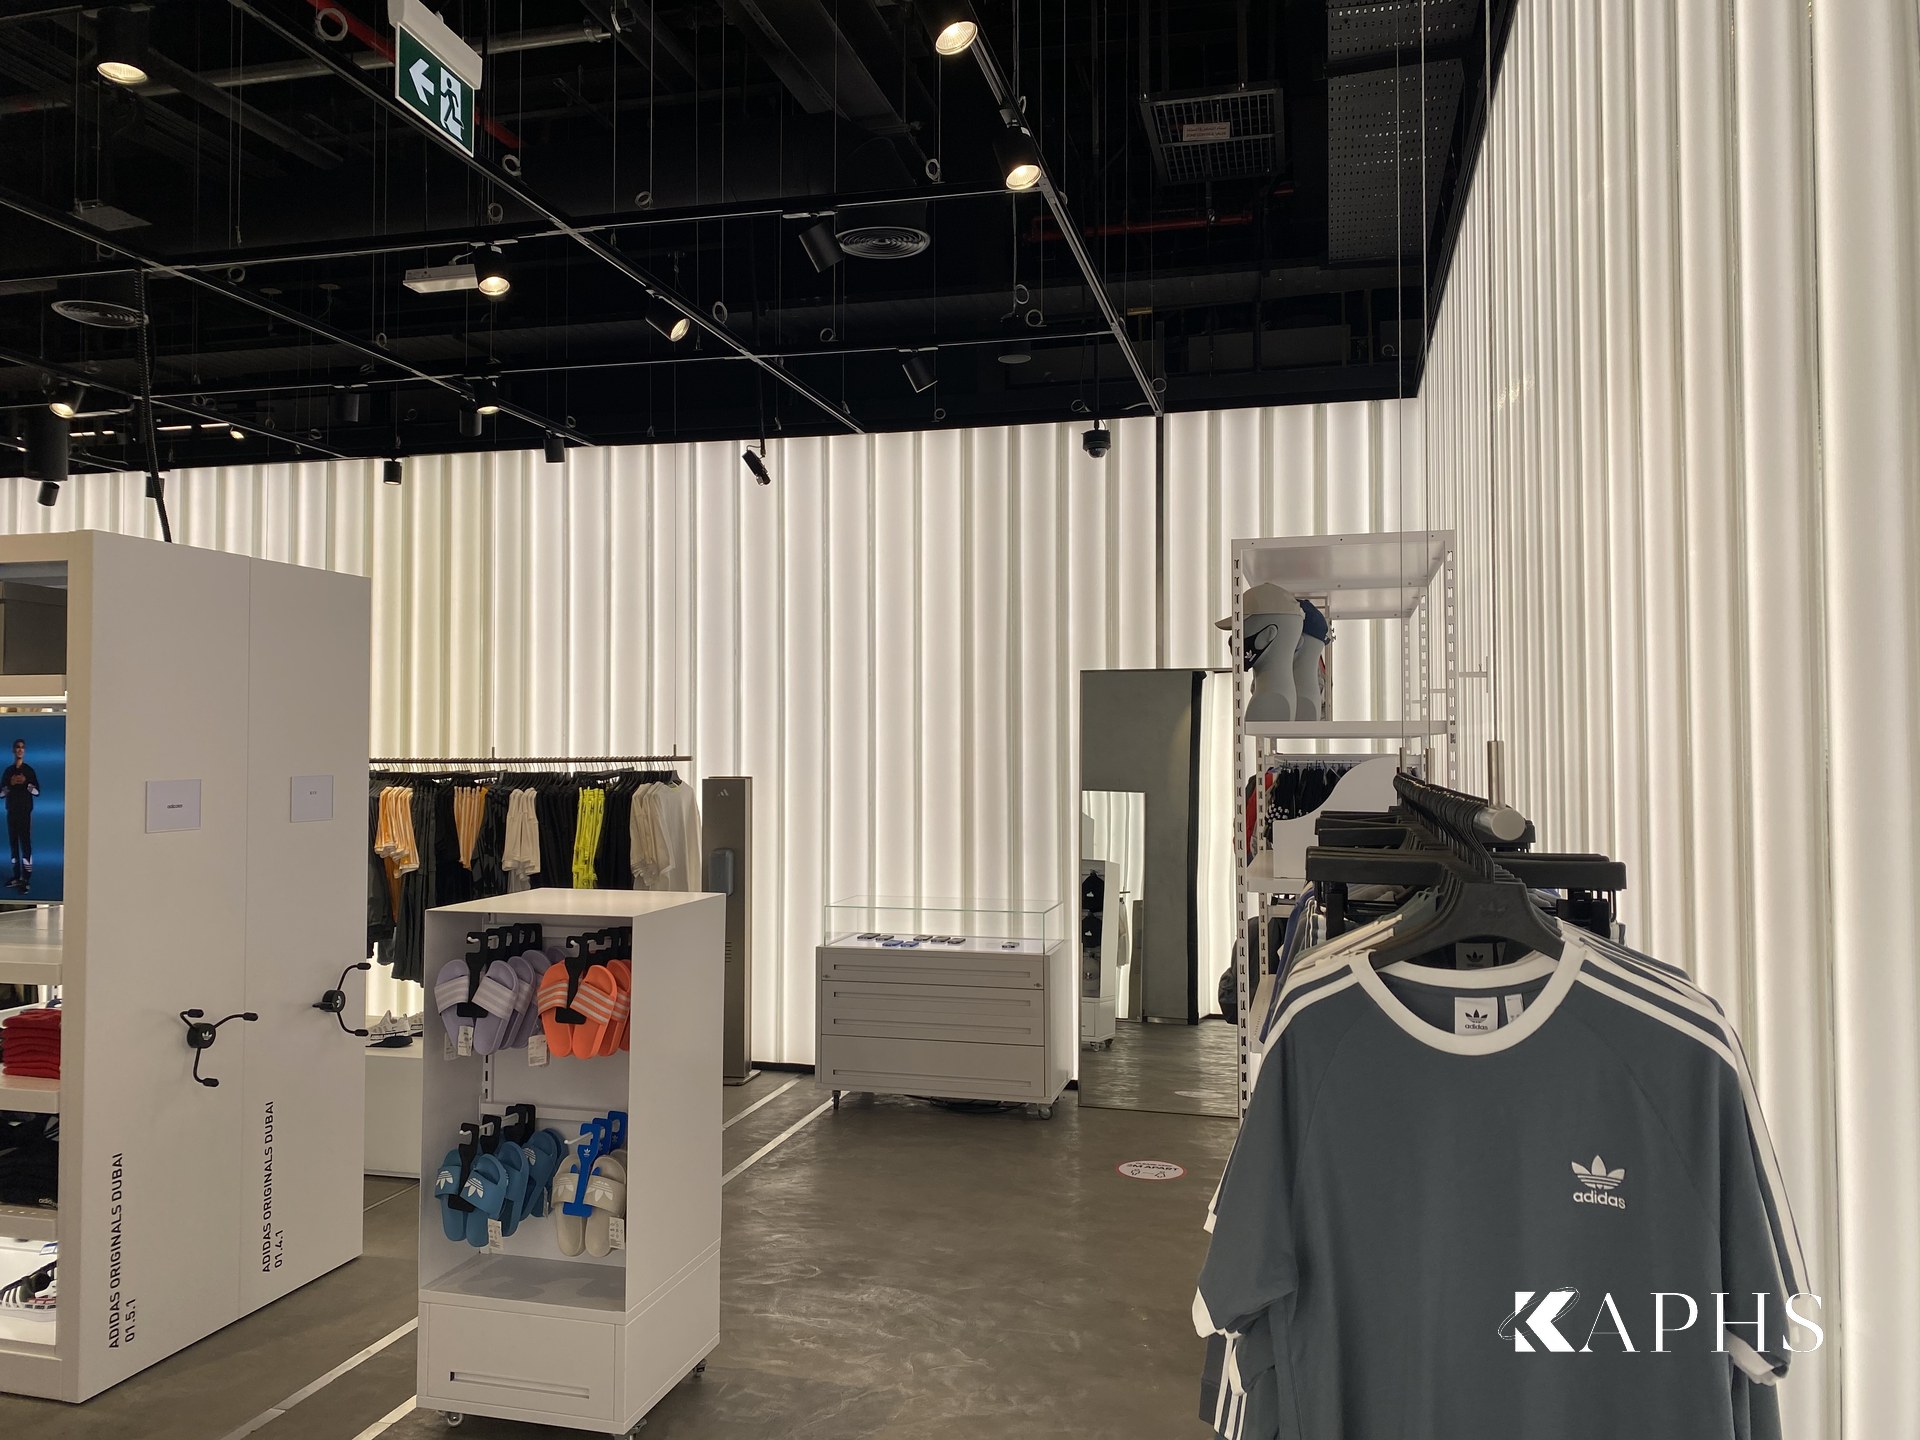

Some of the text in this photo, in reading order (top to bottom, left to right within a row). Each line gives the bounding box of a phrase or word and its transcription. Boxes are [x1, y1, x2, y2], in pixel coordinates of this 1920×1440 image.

[1464, 1023, 1489, 1031] adidas
[262, 1101, 274, 1272] ADIDAS ORIGINALS DUBAI
[1573, 1190, 1626, 1209] adidas
[108, 1152, 123, 1348] ADIDAS ORIGINALS DUBAI
[274, 1230, 284, 1268] 01.4.1
[124, 1298, 136, 1343] 01.5.1
